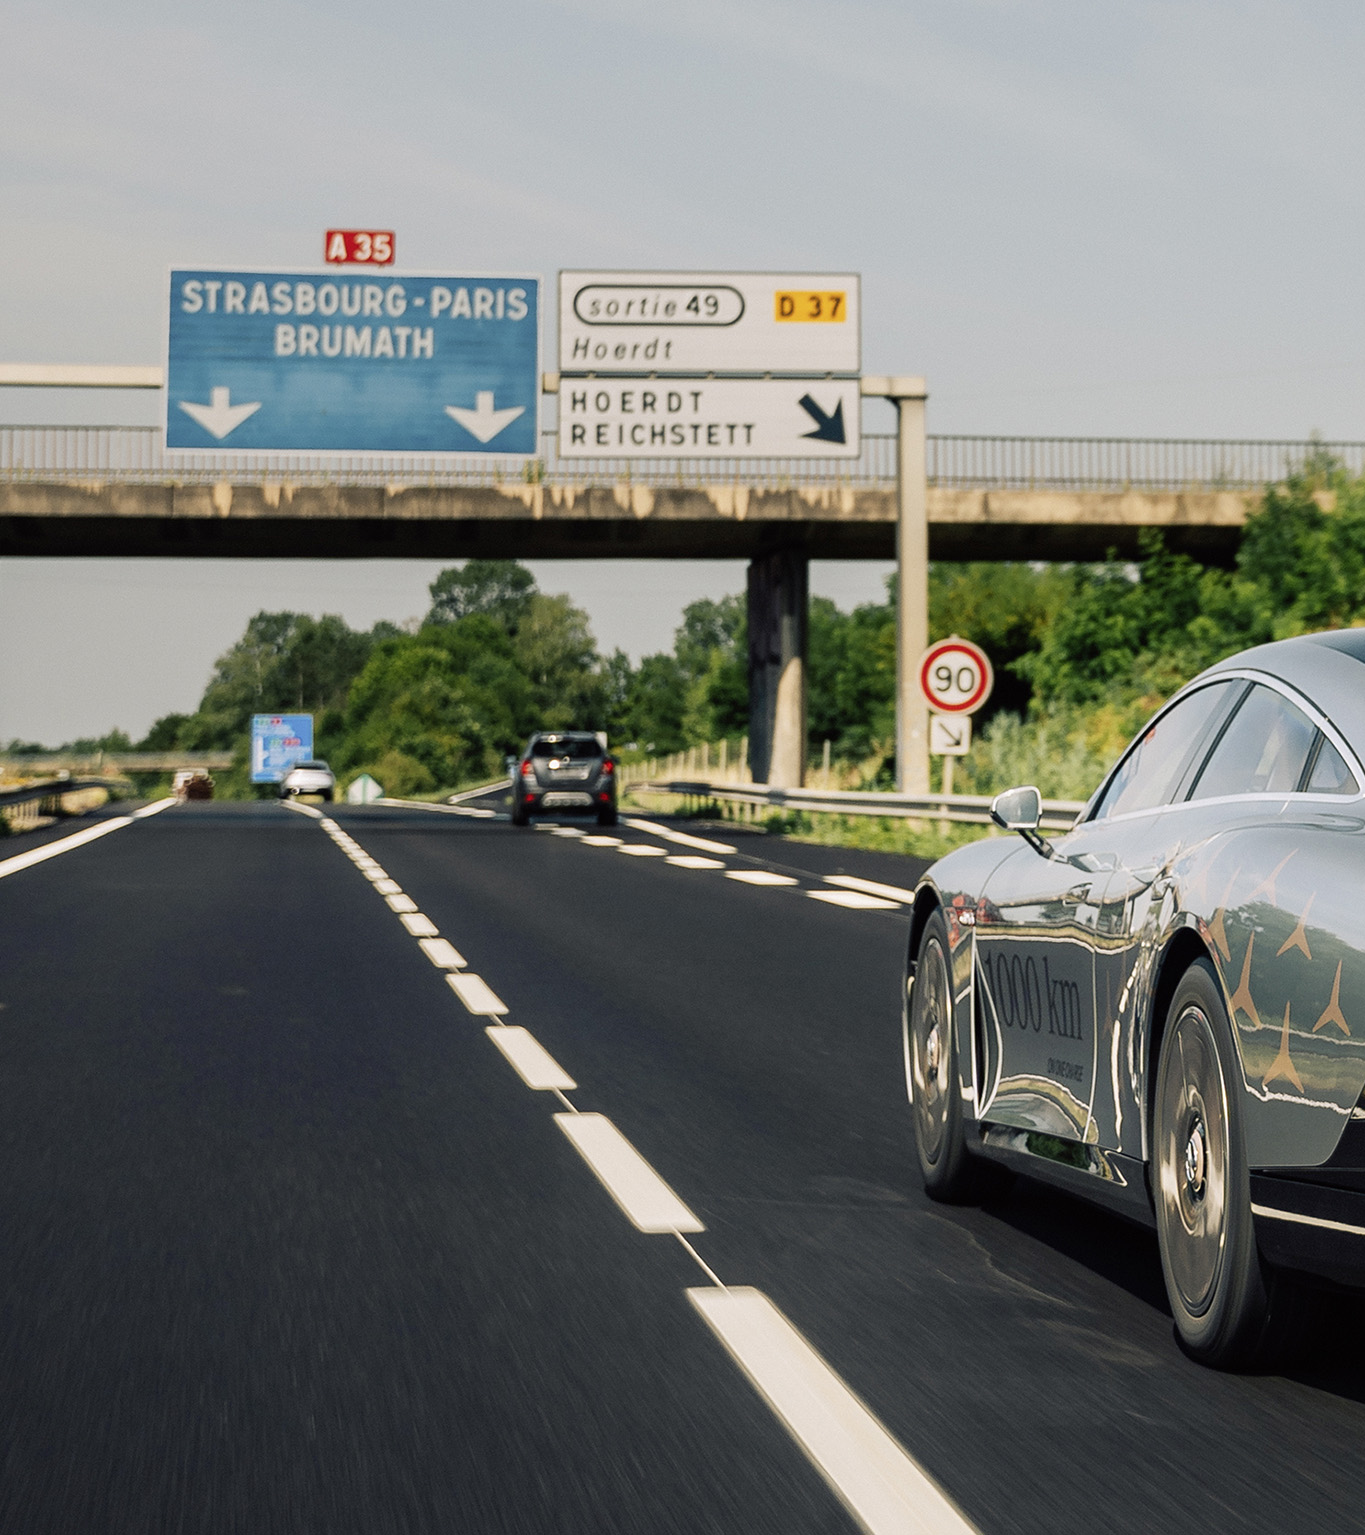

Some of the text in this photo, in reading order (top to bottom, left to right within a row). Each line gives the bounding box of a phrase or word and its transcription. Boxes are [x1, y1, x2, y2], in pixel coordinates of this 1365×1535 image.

[328, 232, 391, 261] A 35
[182, 280, 407, 317] STRASBOURG
[430, 285, 528, 321] PARIS
[588, 294, 719, 317] sortie 49
[780, 295, 842, 319] D 37
[275, 323, 434, 359] BRUMATH
[572, 337, 673, 360] Hoerdt
[571, 391, 702, 413] HOERDT
[572, 424, 755, 445] REICHSTETT
[935, 666, 975, 692] 90
[985, 950, 1083, 1040] 1000 km
